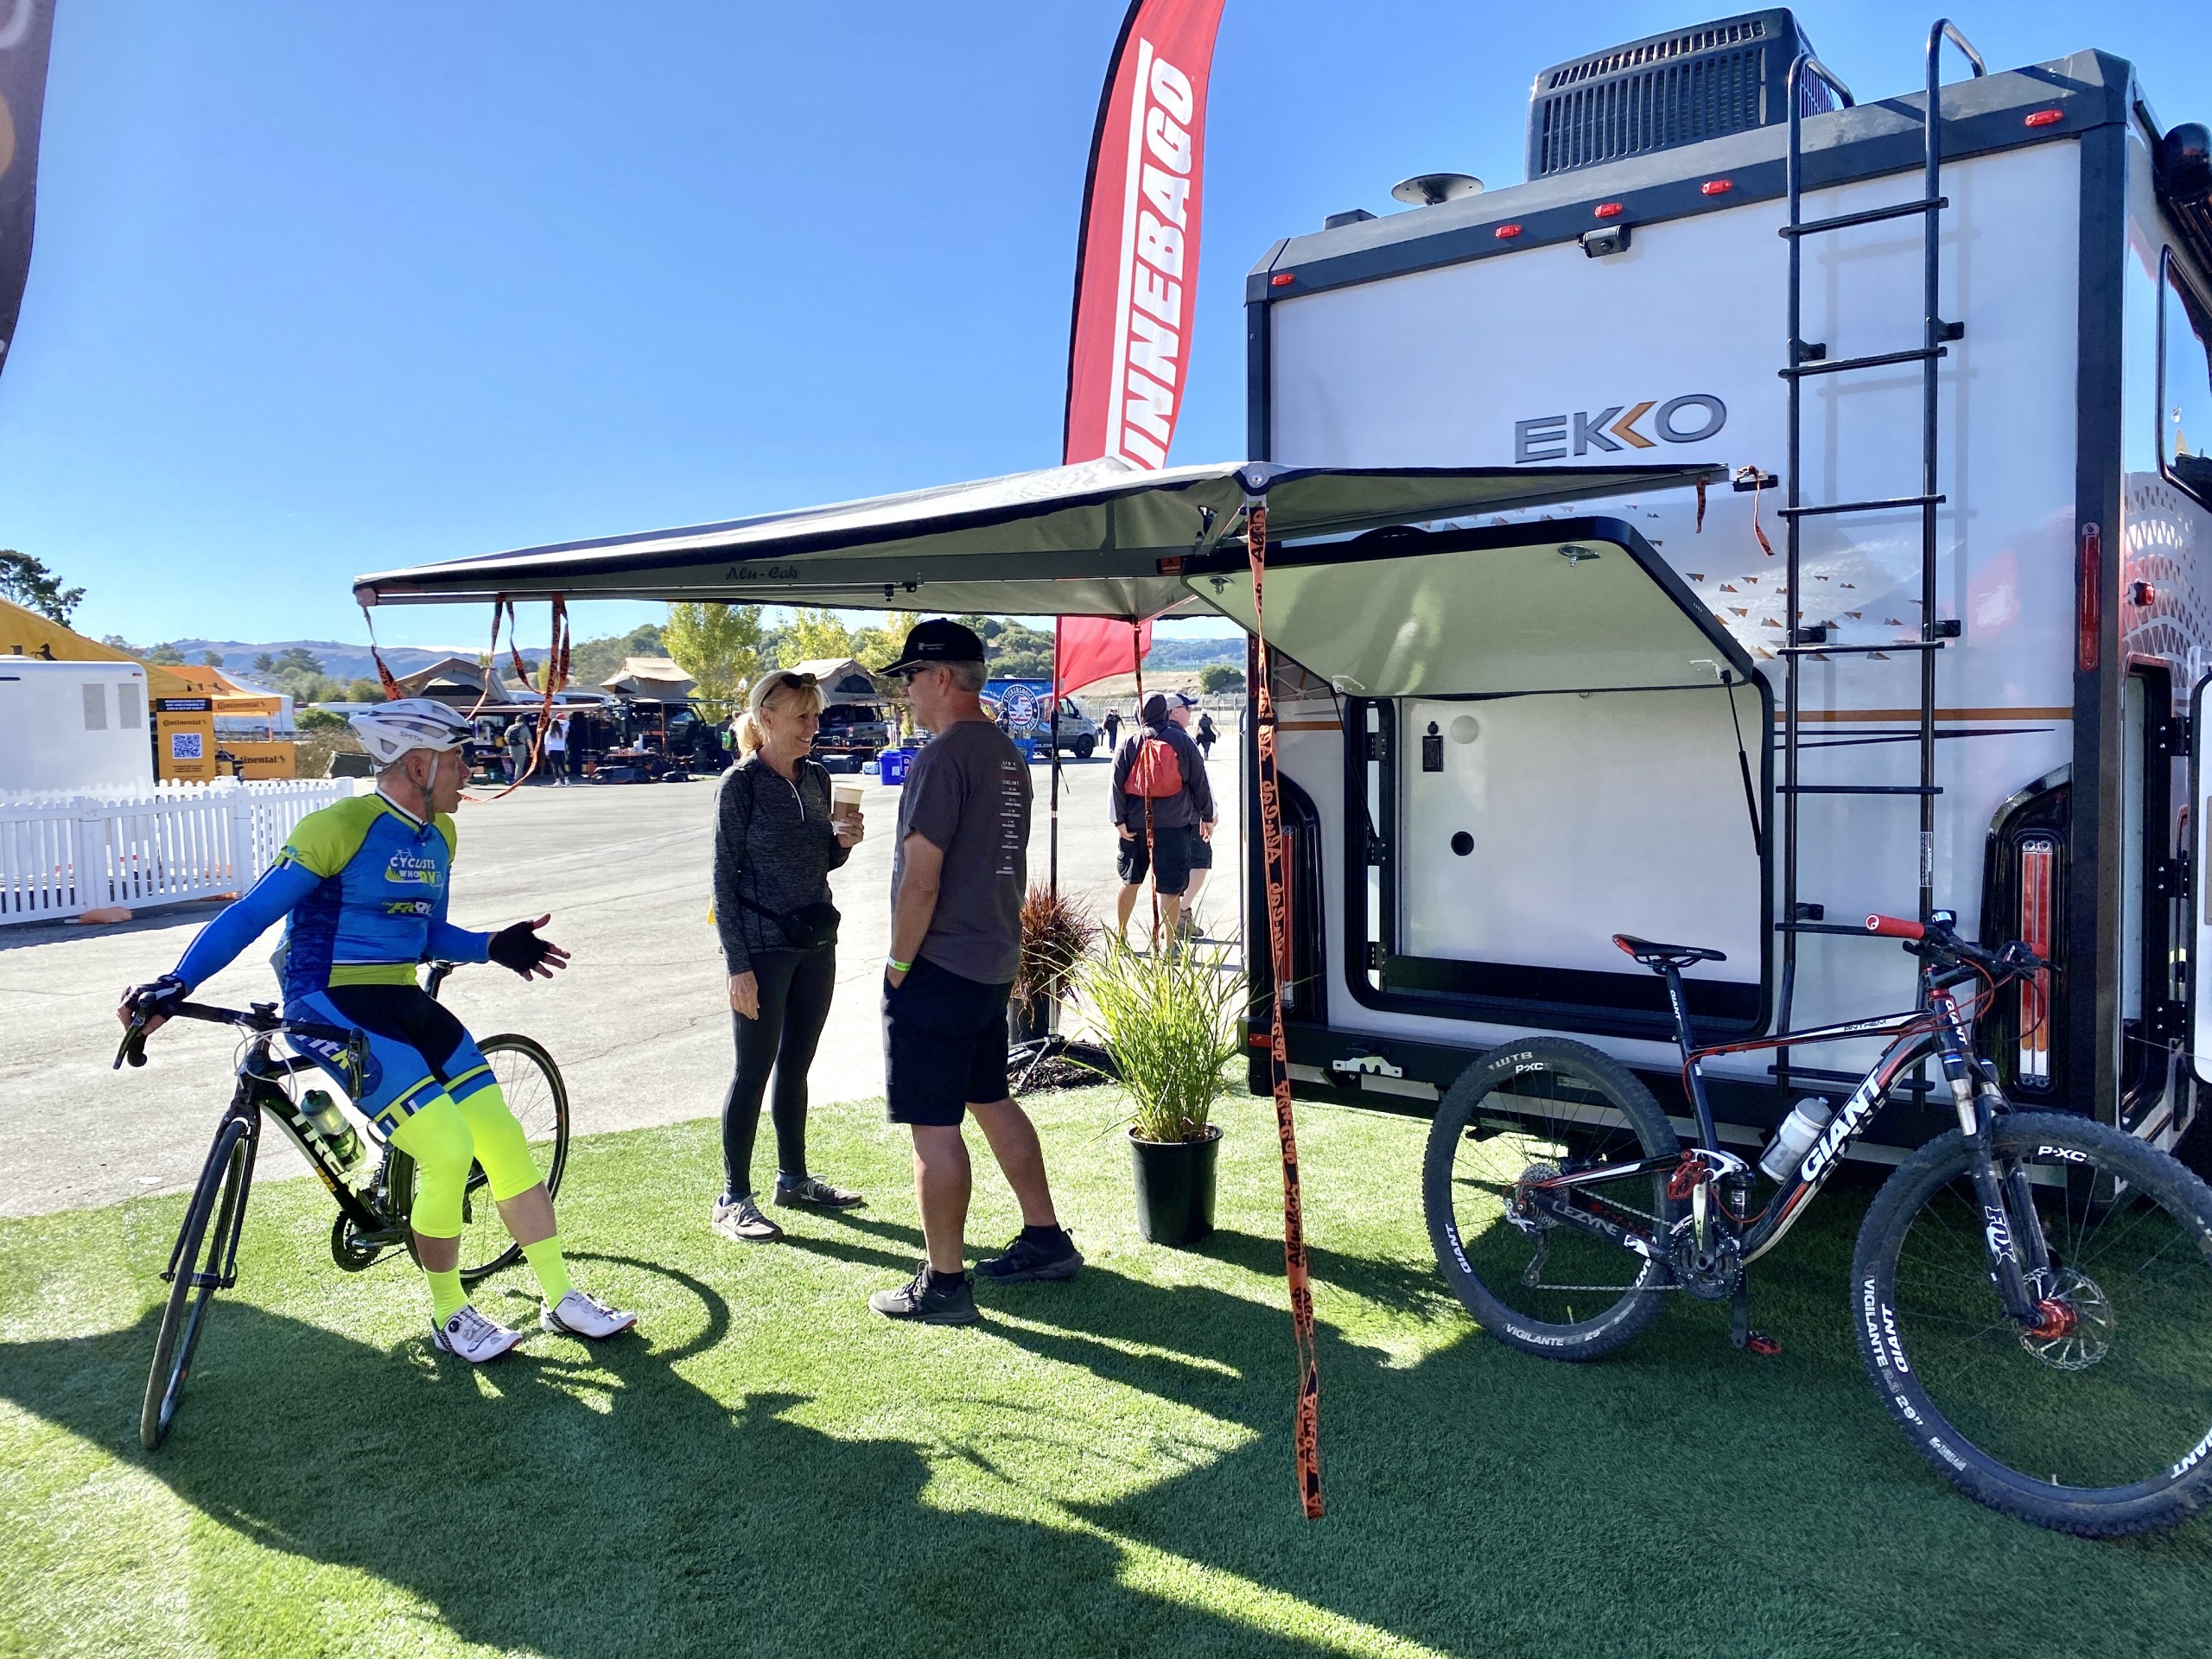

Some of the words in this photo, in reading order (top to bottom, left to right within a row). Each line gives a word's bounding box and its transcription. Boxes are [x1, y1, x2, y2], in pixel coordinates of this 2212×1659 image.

[1105, 36, 1193, 471] INNEBAGO
[162, 719, 201, 728] Continental
[218, 701, 259, 710] Continental
[399, 731, 423, 743] SMITH
[390, 856, 435, 869] CYCLISTS
[399, 869, 420, 878] WHO
[1669, 989, 1682, 1021] GIANT
[1945, 999, 1968, 1046] GIANT
[1843, 1019, 1887, 1032] ANTHEM
[1801, 1066, 1881, 1182] GIANT
[291, 1112, 358, 1199] TREK
[1552, 1200, 1620, 1236] LEZYNE
[1445, 1223, 1472, 1274] GIANT
[1505, 1325, 1564, 1346] VIGILANTE
[1864, 1278, 1889, 1368] VIGILANTE
[1881, 1303, 1909, 1373] GIANT
[2171, 1427, 2212, 1479] IANT
